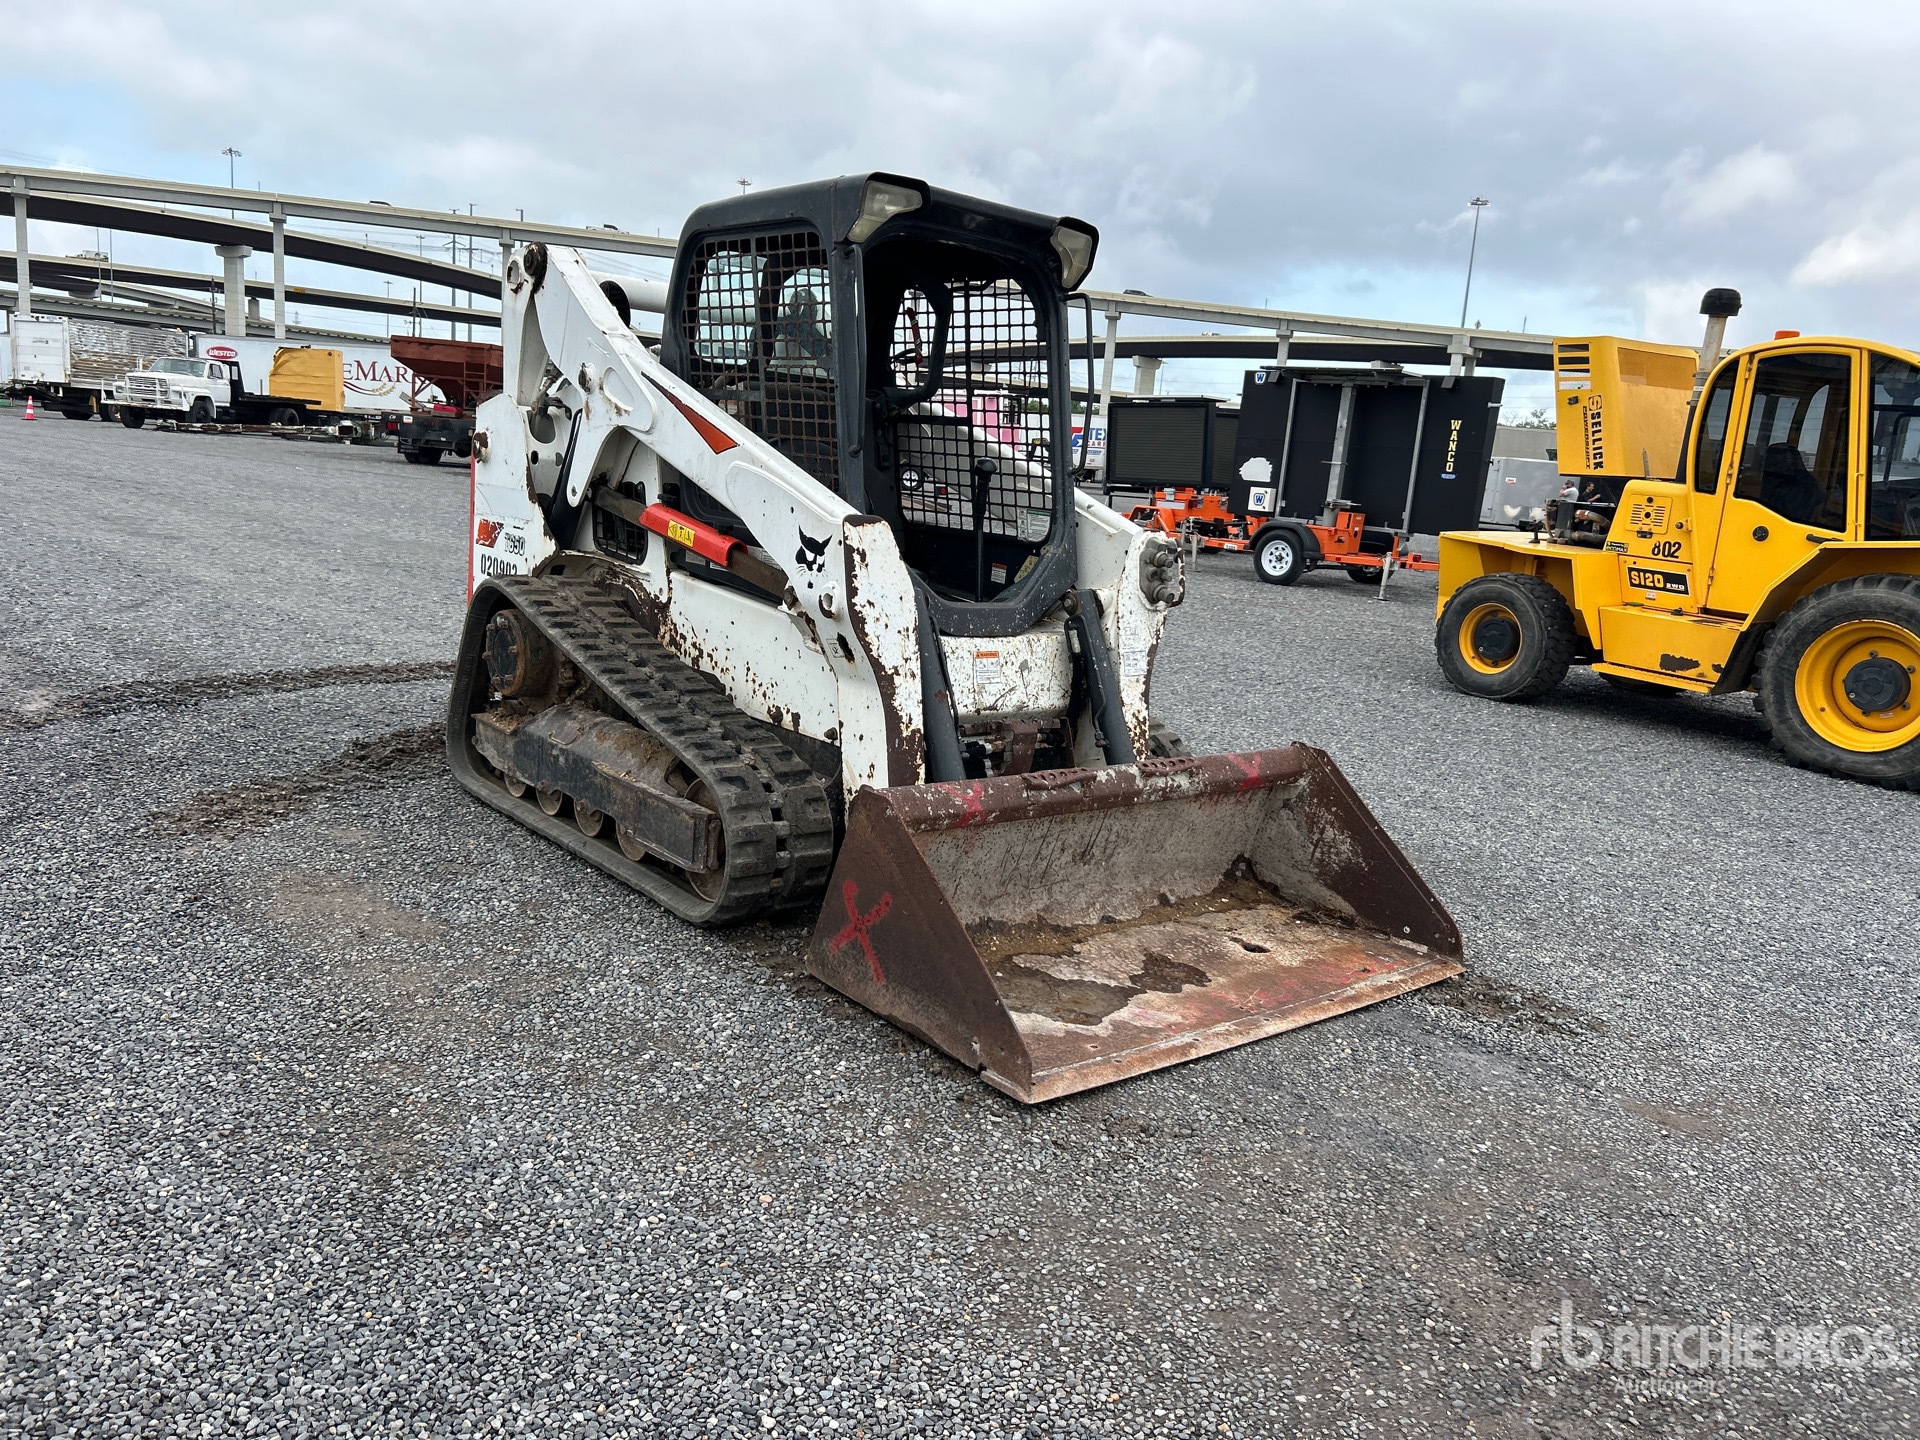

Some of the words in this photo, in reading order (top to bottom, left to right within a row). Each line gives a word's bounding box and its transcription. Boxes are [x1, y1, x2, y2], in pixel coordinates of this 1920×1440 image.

[208, 349, 236, 357] WESTCO
[1445, 419, 1462, 473] WANCO
[1591, 411, 1604, 470] SELLICK
[1652, 541, 1682, 559] 802
[1631, 571, 1664, 588] S120
